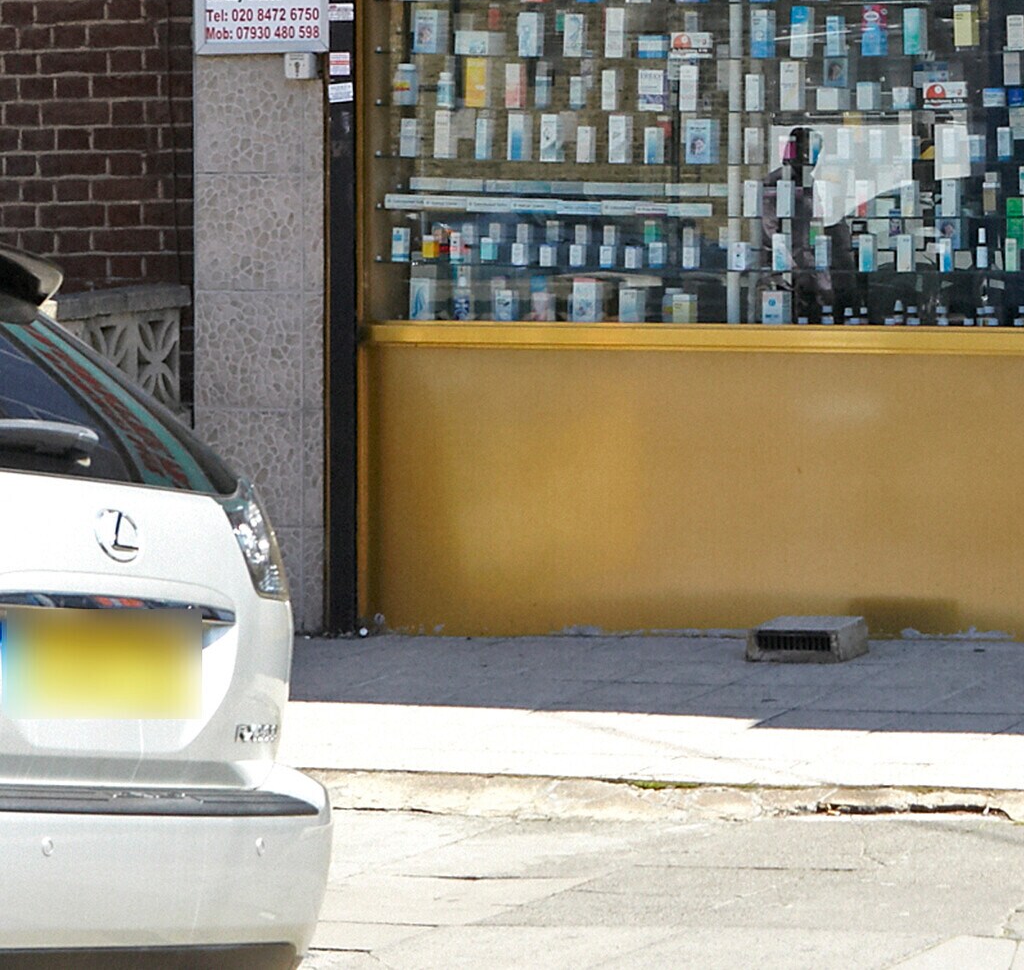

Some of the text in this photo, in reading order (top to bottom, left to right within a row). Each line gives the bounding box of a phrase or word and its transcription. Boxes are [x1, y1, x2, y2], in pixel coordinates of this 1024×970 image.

[206, 9, 228, 22] Tel:
[231, 9, 253, 22] 020
[257, 8, 286, 21] 8472
[290, 8, 319, 21] 6750
[205, 25, 320, 40] Mob: 07930 480 598
